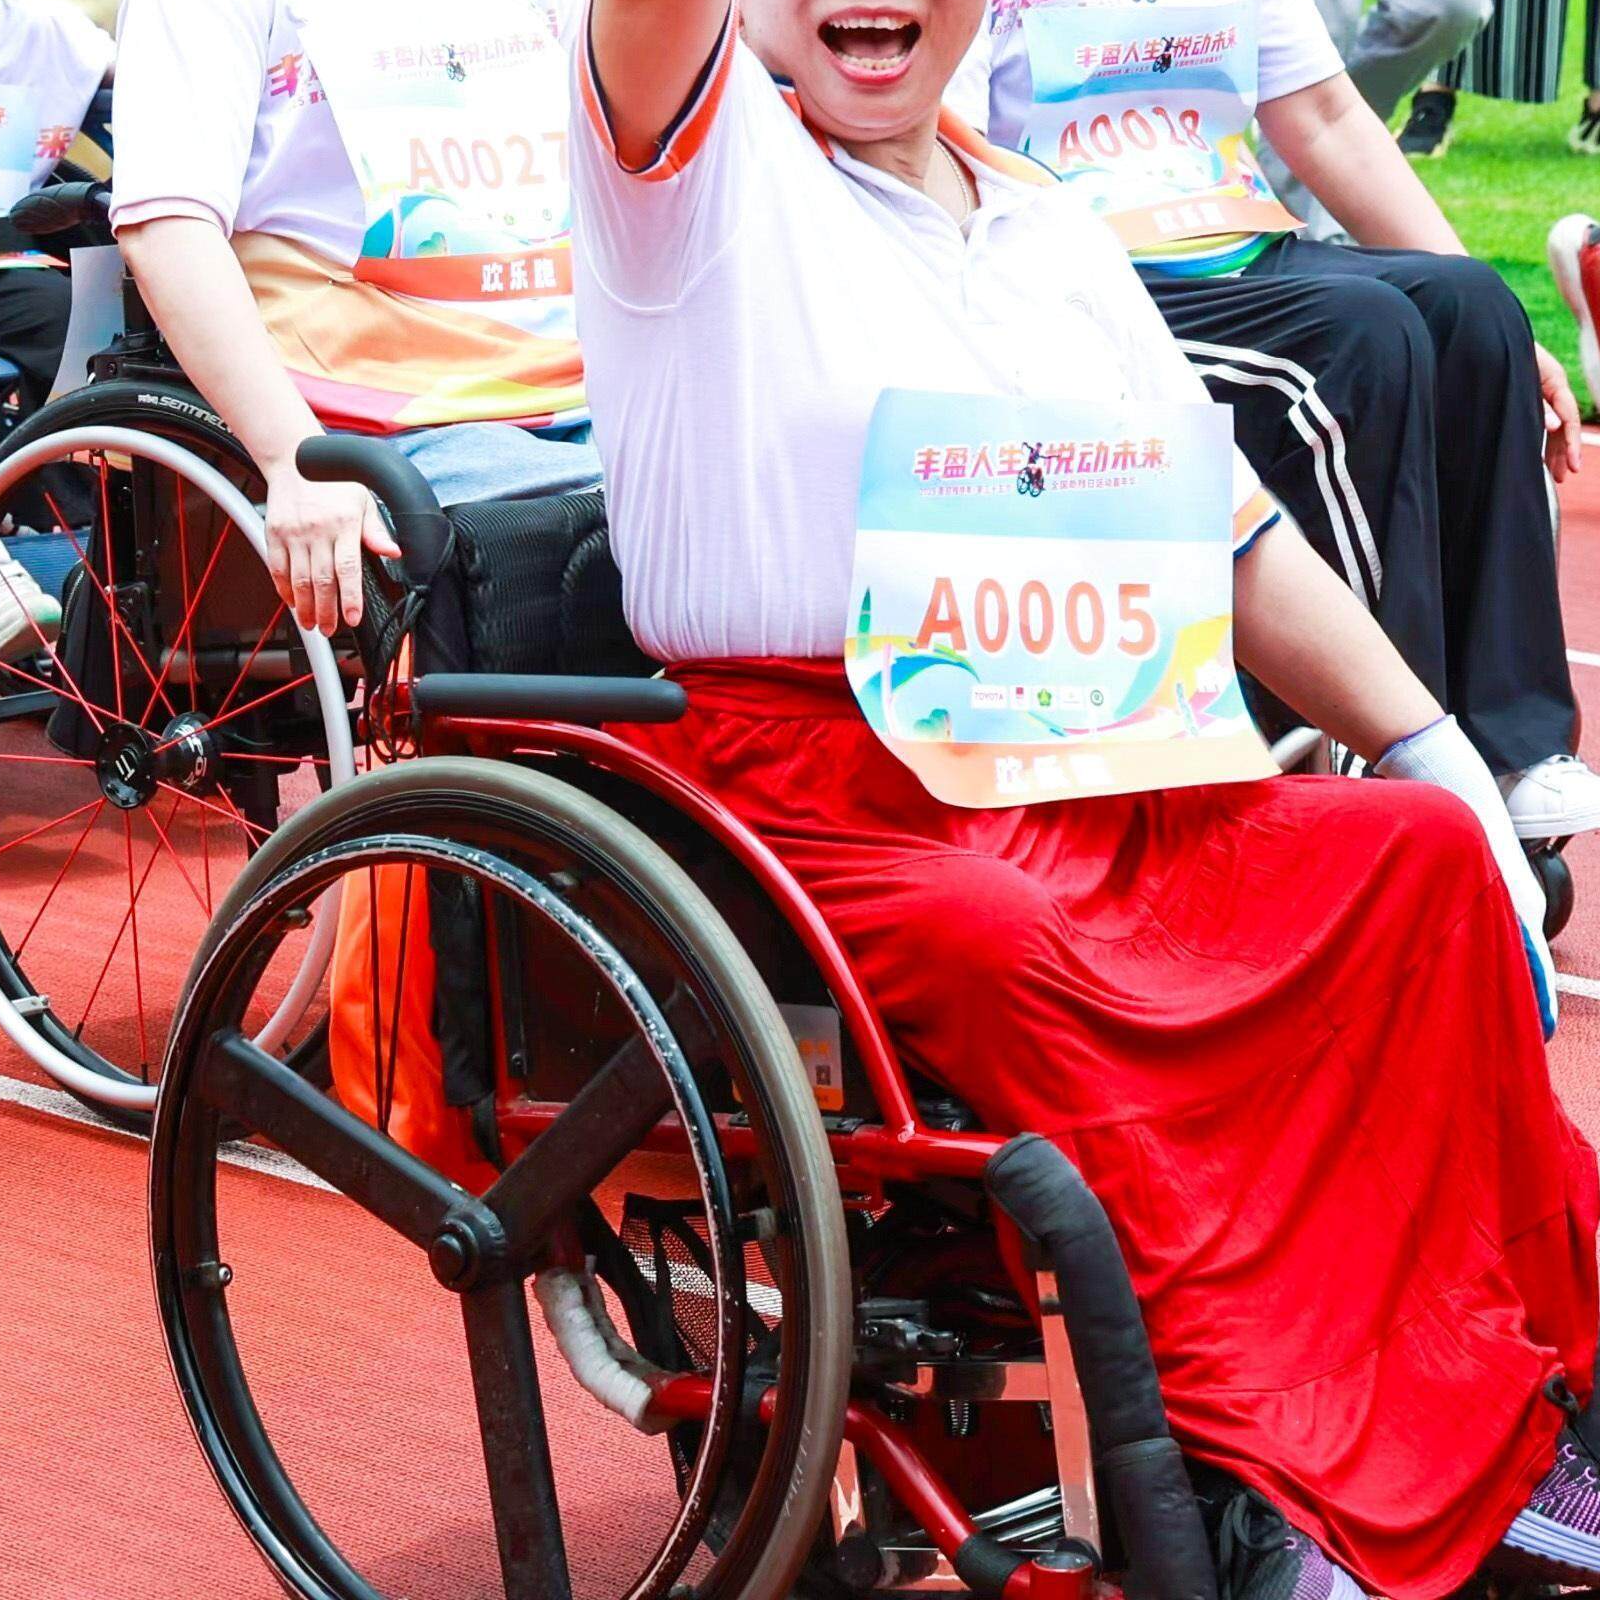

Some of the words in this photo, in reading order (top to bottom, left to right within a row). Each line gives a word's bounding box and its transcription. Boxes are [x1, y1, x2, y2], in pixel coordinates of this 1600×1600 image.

[914, 445, 1024, 481] 丰盈人生
[1046, 438, 1166, 475] 悦动未来
[913, 577, 1156, 656] A0005
